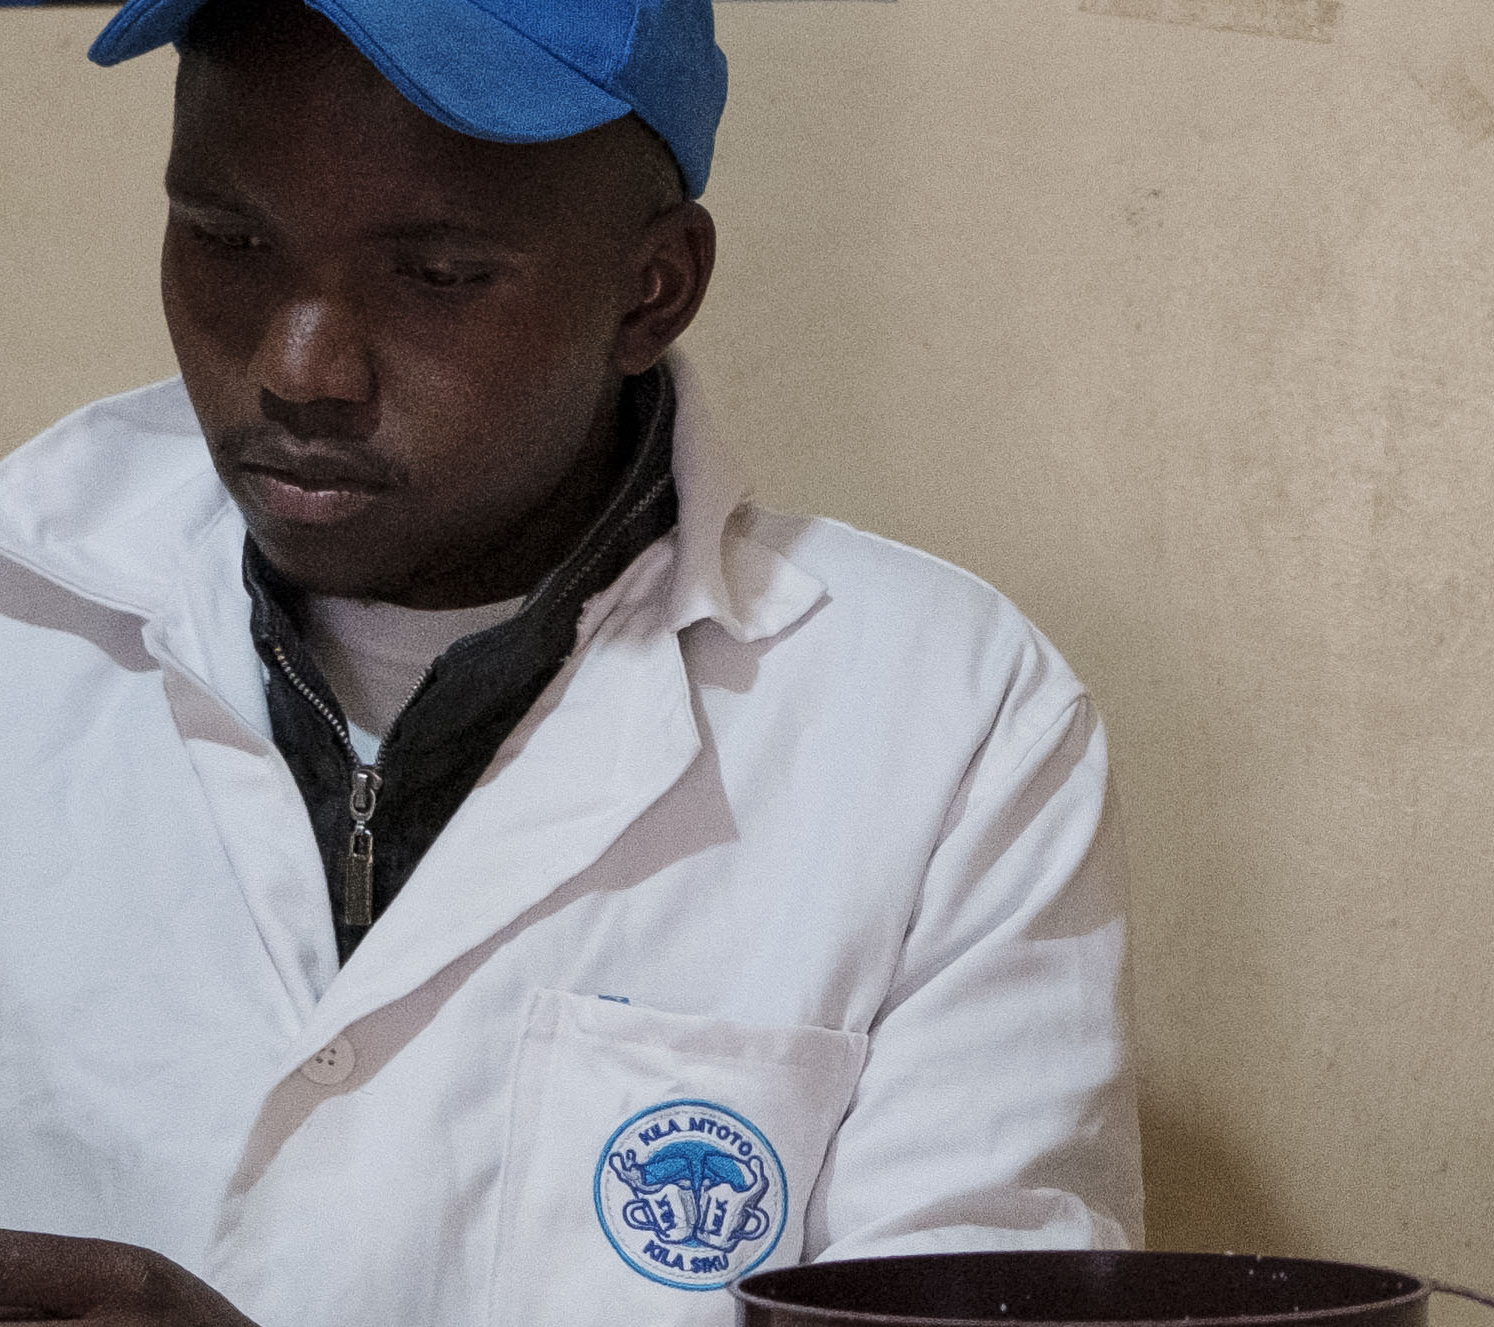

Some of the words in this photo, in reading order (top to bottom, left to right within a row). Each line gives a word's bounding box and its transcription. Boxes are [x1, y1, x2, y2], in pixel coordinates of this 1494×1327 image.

[638, 1118, 682, 1147] KILA
[688, 1116, 754, 1158] MTOTO
[641, 1240, 685, 1272] KILA
[690, 1253, 730, 1274] SIKU
